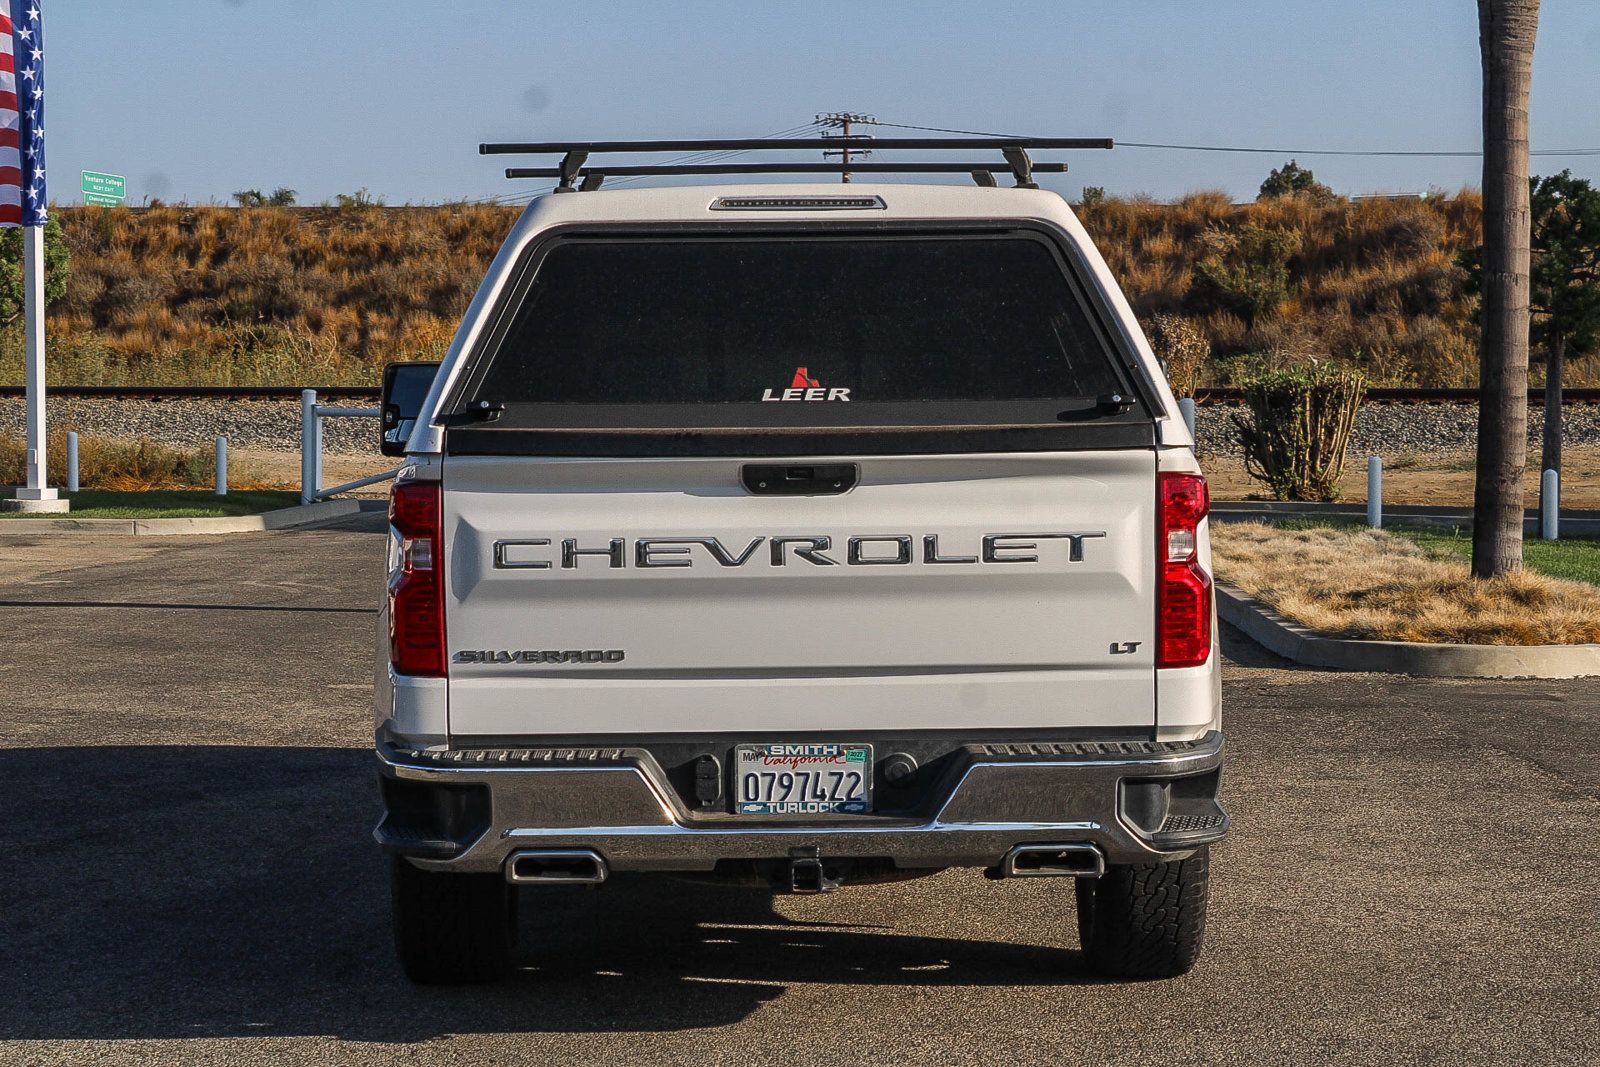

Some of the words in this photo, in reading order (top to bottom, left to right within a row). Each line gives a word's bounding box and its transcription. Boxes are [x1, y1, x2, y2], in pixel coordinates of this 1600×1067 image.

[84, 175, 104, 183] Ventura
[105, 178, 123, 187] College
[762, 388, 851, 402] LEER
[493, 531, 1106, 569] CHEVROLET
[1109, 641, 1142, 654] LT
[453, 650, 625, 664] SILVERADO
[742, 752, 760, 762] MAY
[770, 745, 838, 756] SMITH
[763, 755, 847, 770] California
[767, 802, 840, 814] TURLOCK
